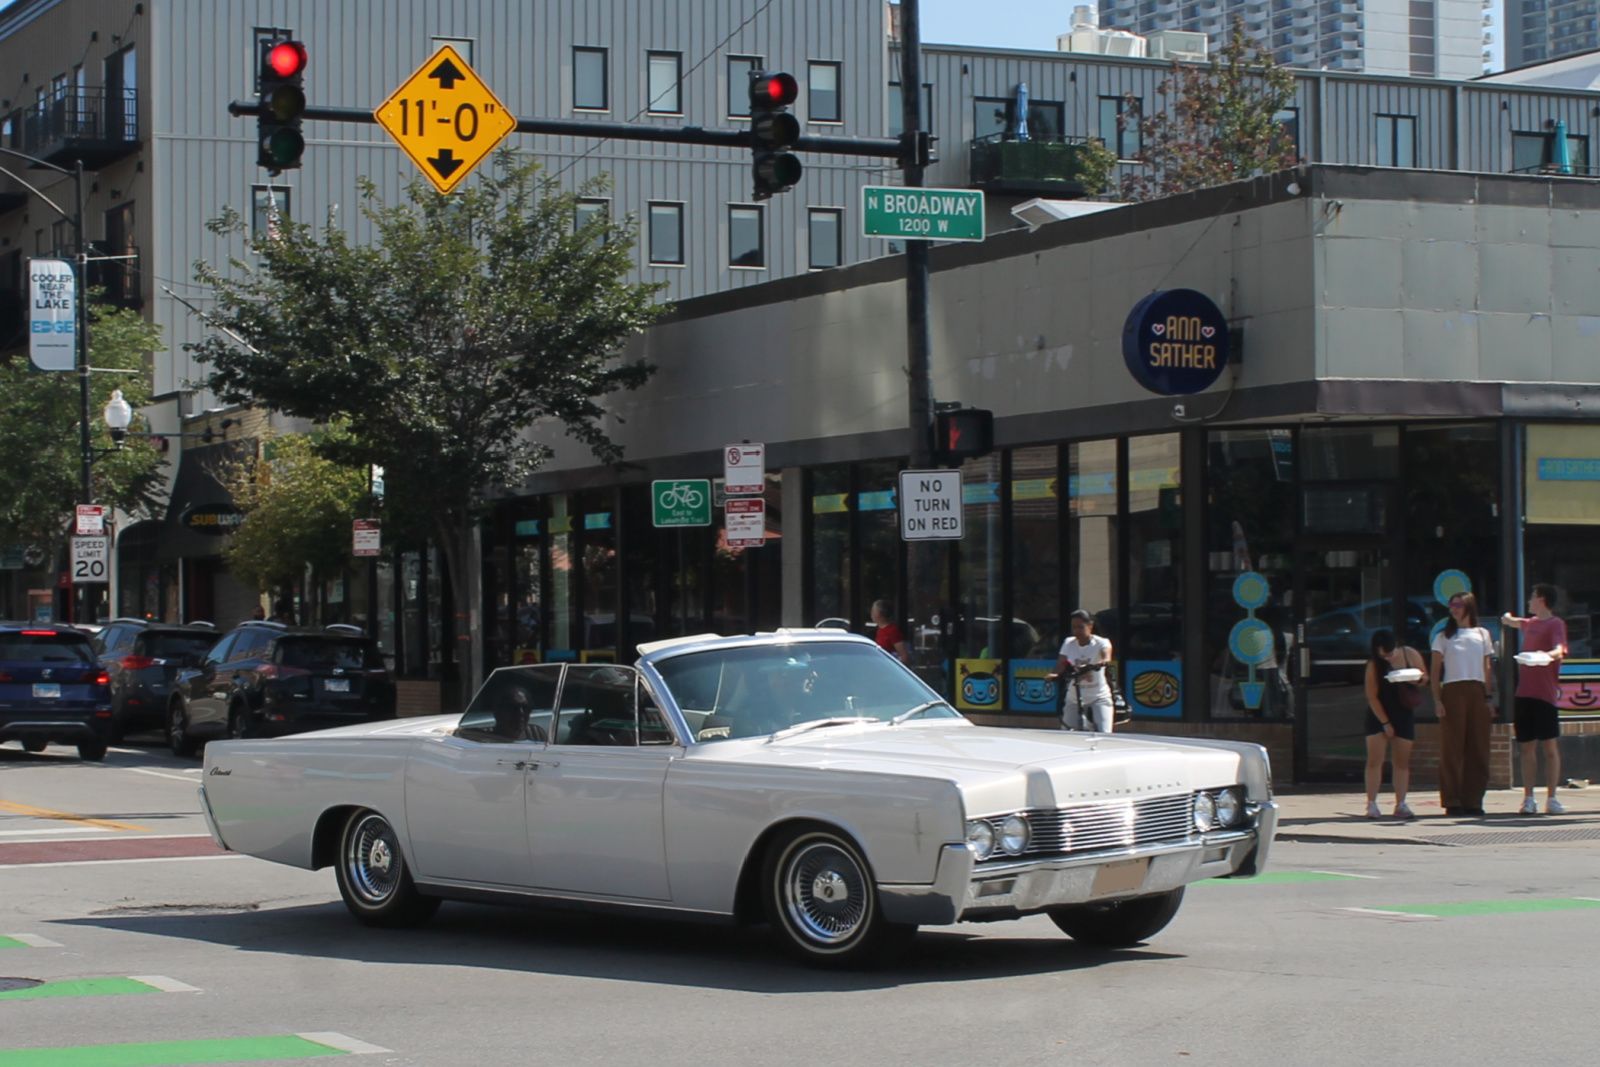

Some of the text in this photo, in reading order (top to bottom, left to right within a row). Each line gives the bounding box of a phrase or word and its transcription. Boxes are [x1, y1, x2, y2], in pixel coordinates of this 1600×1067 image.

[399, 98, 495, 142] 11'-0"
[868, 194, 977, 216] N BROADWAY
[899, 218, 948, 232] 1200 W
[32, 273, 73, 283] COOLER
[39, 283, 65, 291] NEAR
[43, 291, 62, 299] THE
[36, 299, 70, 309] LAKE
[1166, 316, 1202, 341] ANN
[1150, 342, 1216, 369] SATHER
[920, 480, 942, 493] NO
[914, 498, 950, 511] TURN
[191, 513, 242, 526] SUBWA
[908, 517, 958, 531] ON RED
[75, 541, 105, 549] SPEED
[77, 550, 101, 558] LIMIT
[76, 560, 104, 577] 20
